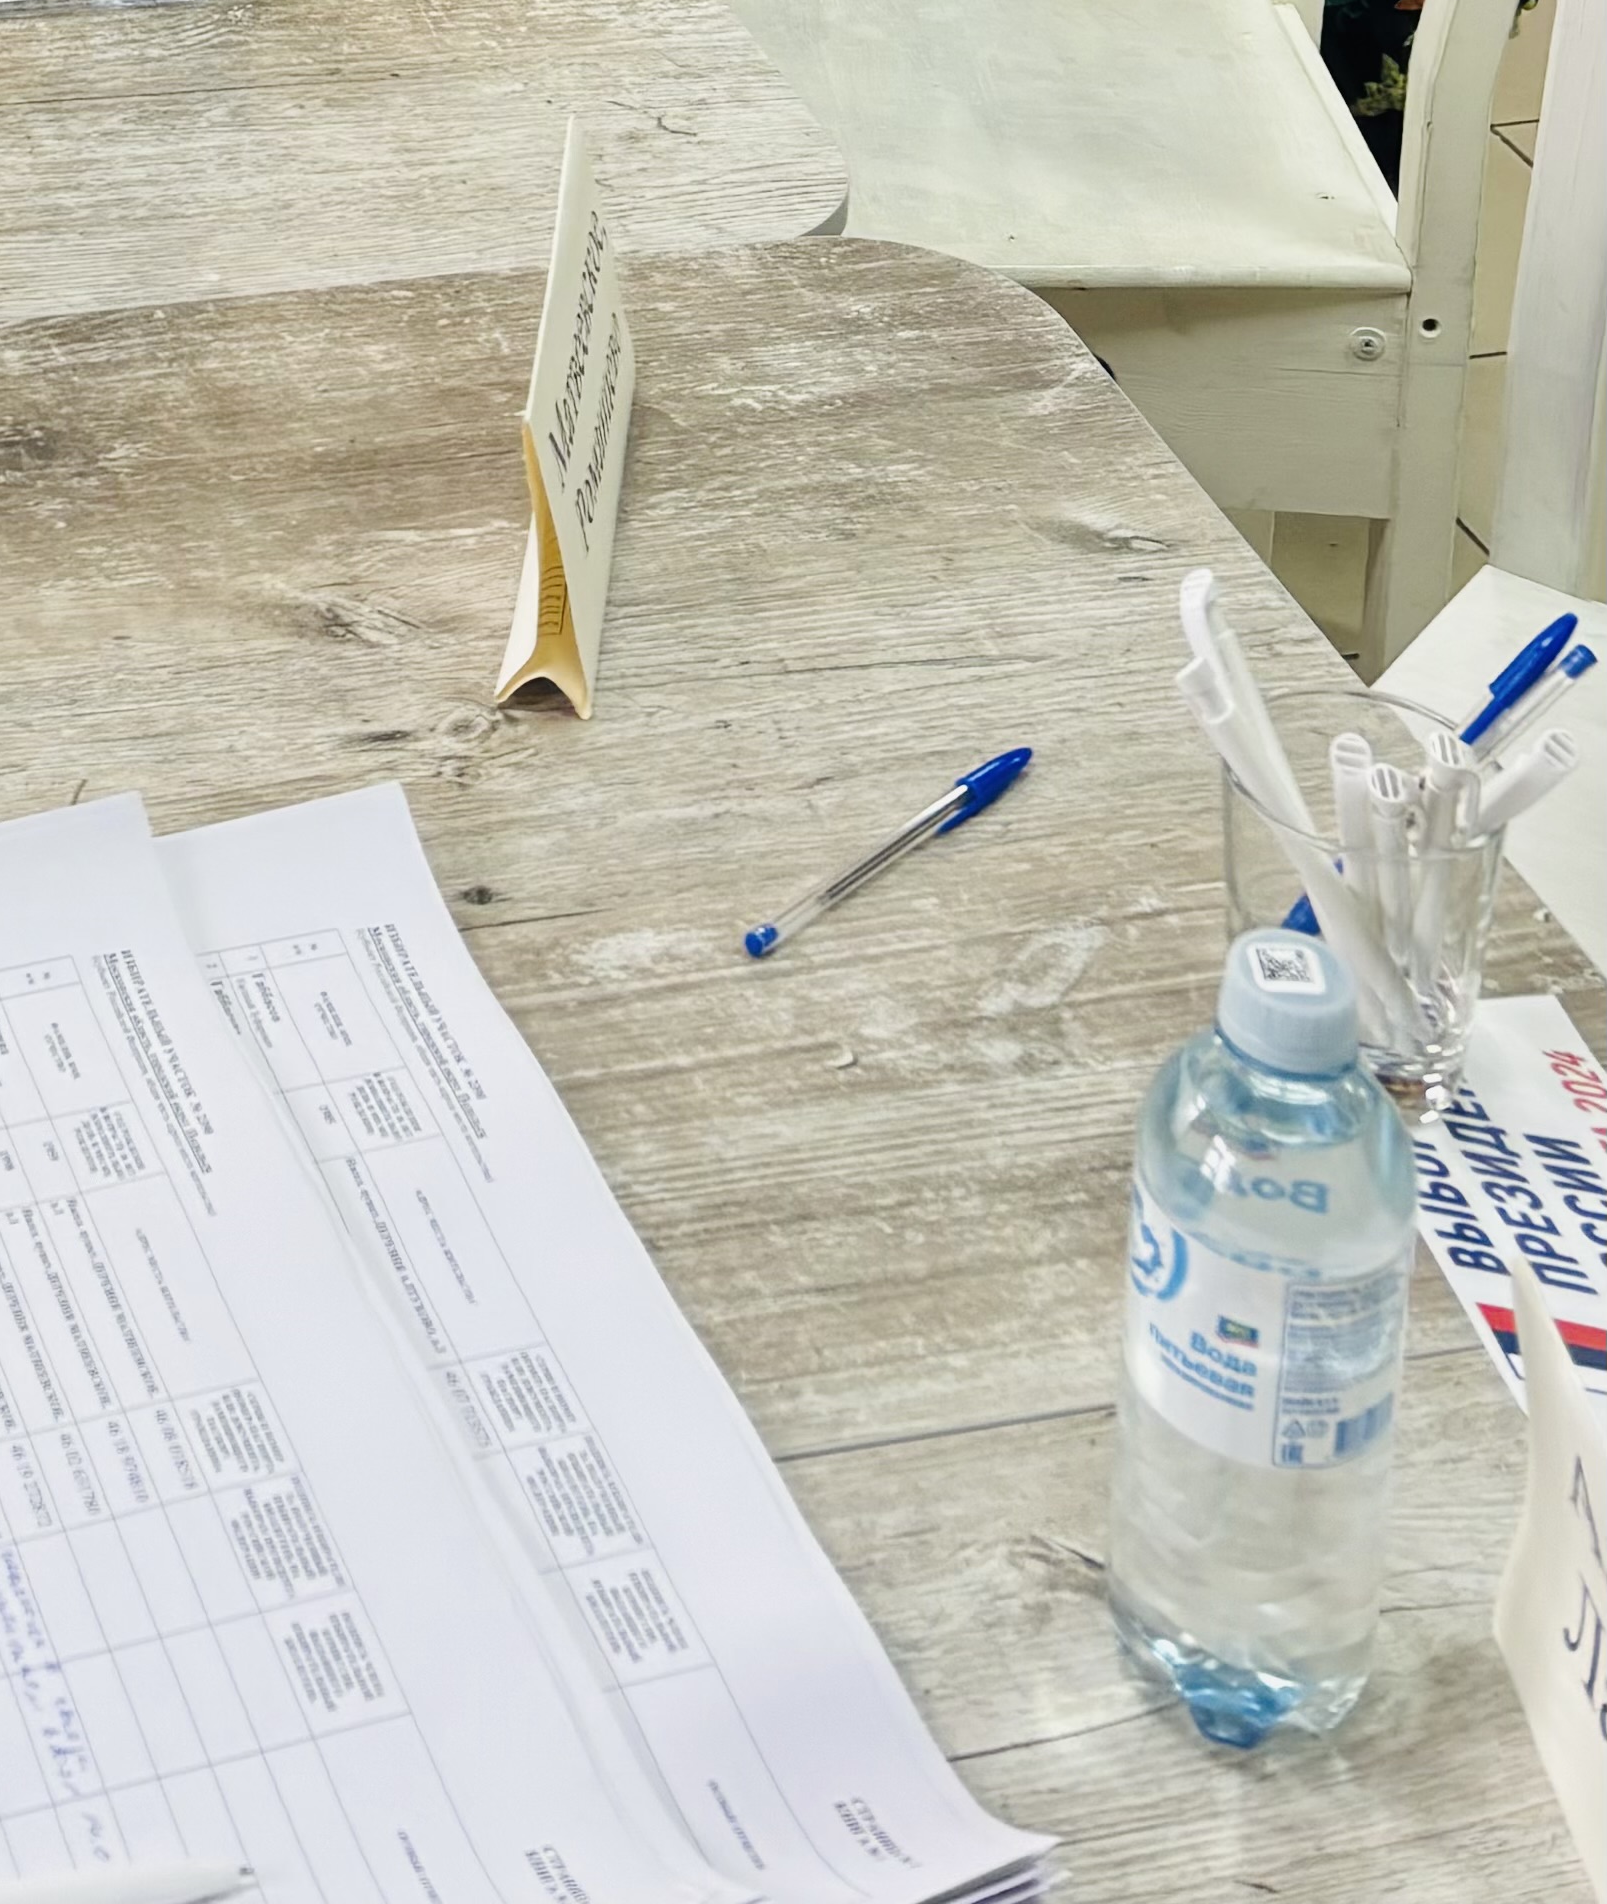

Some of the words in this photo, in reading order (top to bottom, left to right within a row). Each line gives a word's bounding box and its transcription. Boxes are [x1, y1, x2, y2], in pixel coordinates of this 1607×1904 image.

[1542, 1049, 1607, 1114] 2024
[1443, 1088, 1599, 1296] ПРЕЗИДЕ
[1190, 1331, 1257, 1377] Вода
